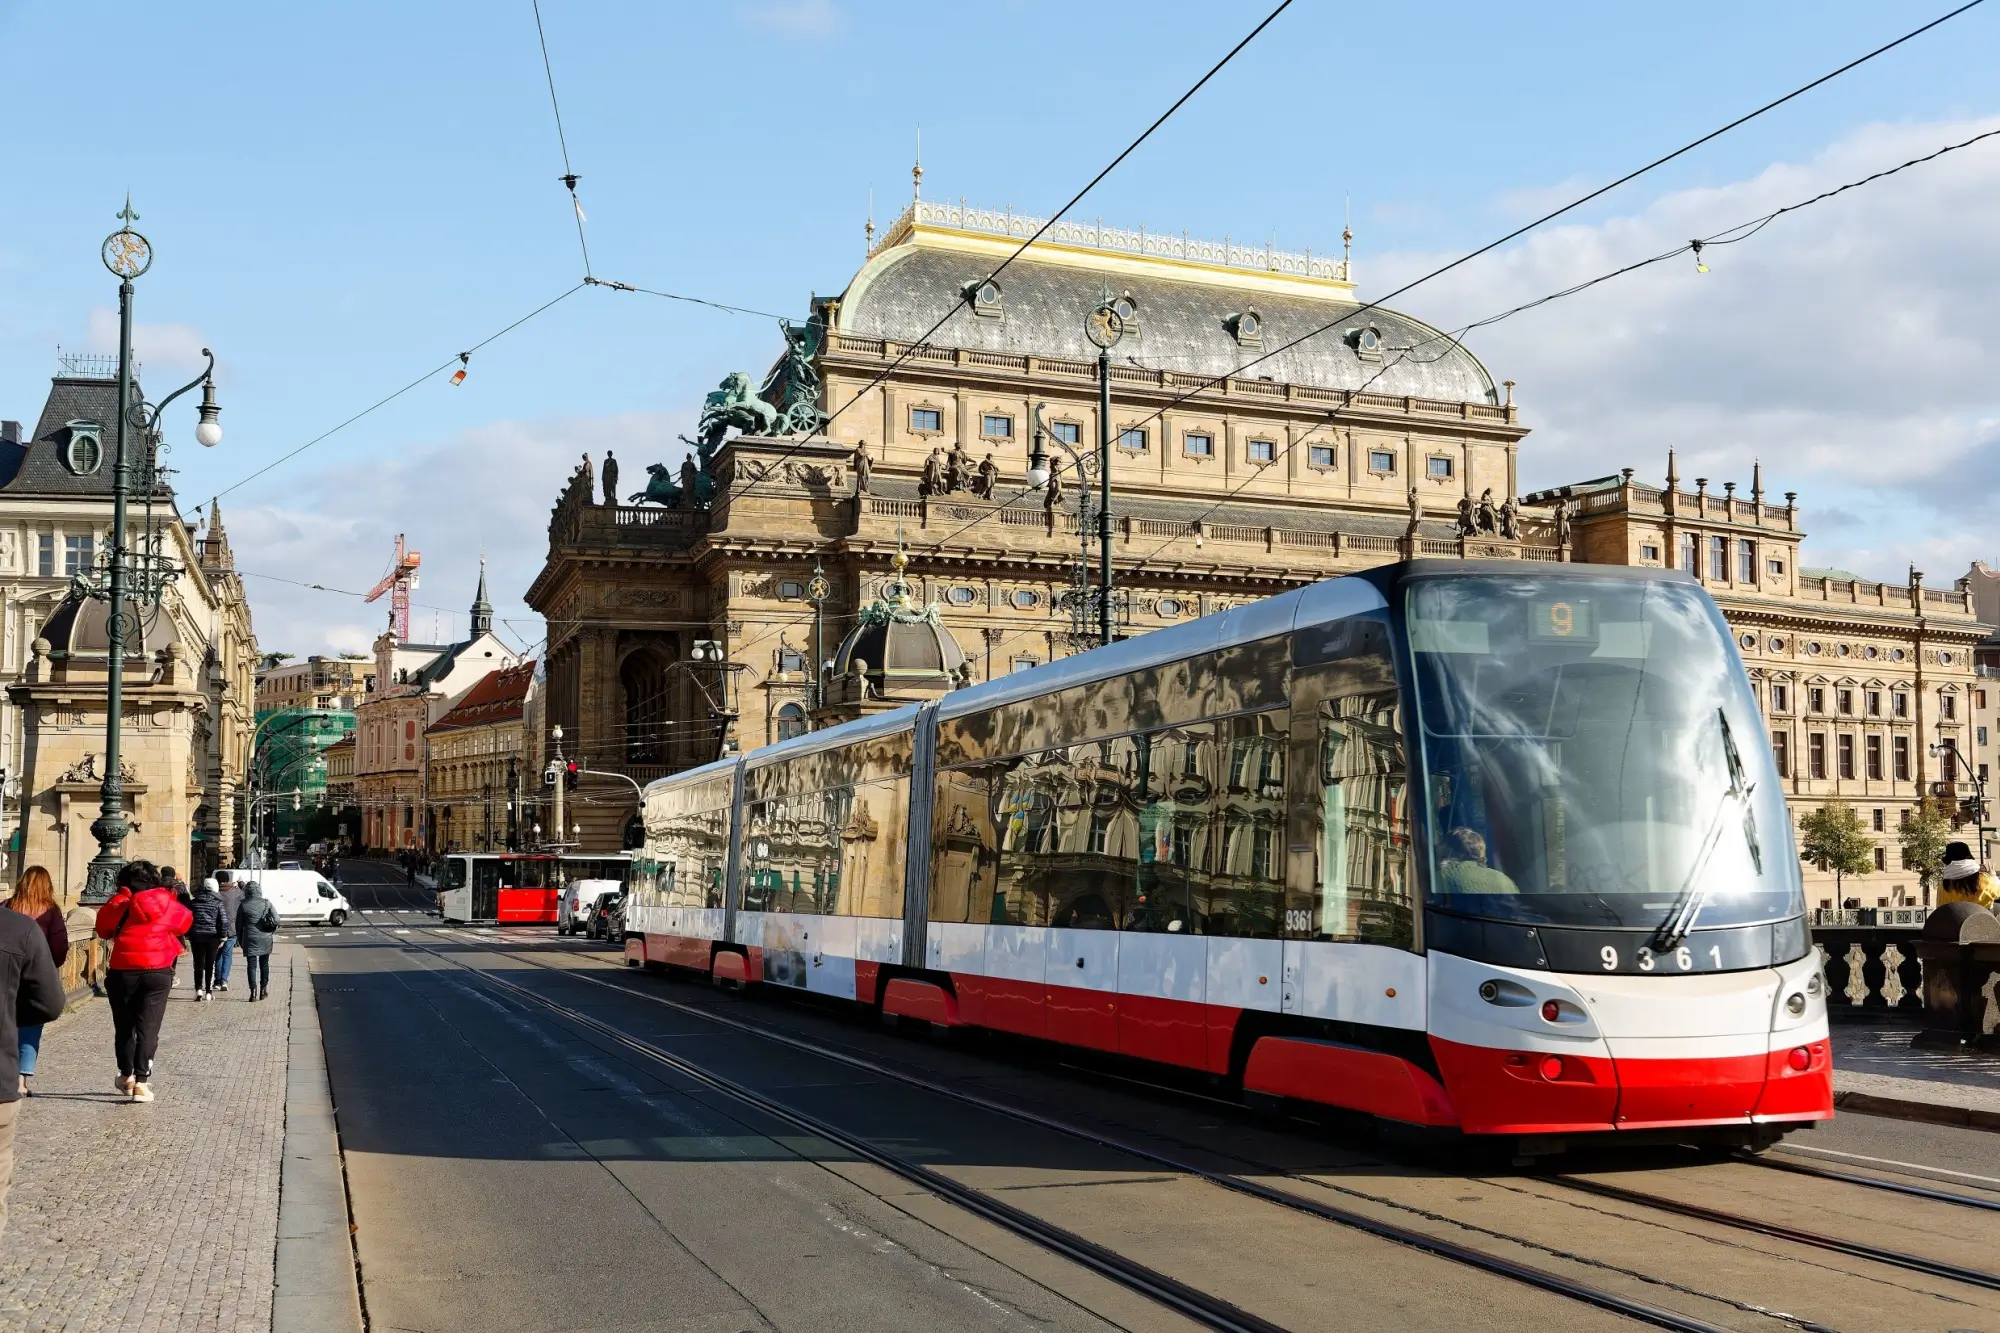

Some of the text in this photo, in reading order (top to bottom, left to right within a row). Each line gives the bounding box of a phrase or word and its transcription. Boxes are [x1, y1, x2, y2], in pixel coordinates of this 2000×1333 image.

[1551, 602, 1573, 636] 9
[1286, 909, 1313, 932] 9361
[1600, 945, 1723, 971] 9361
